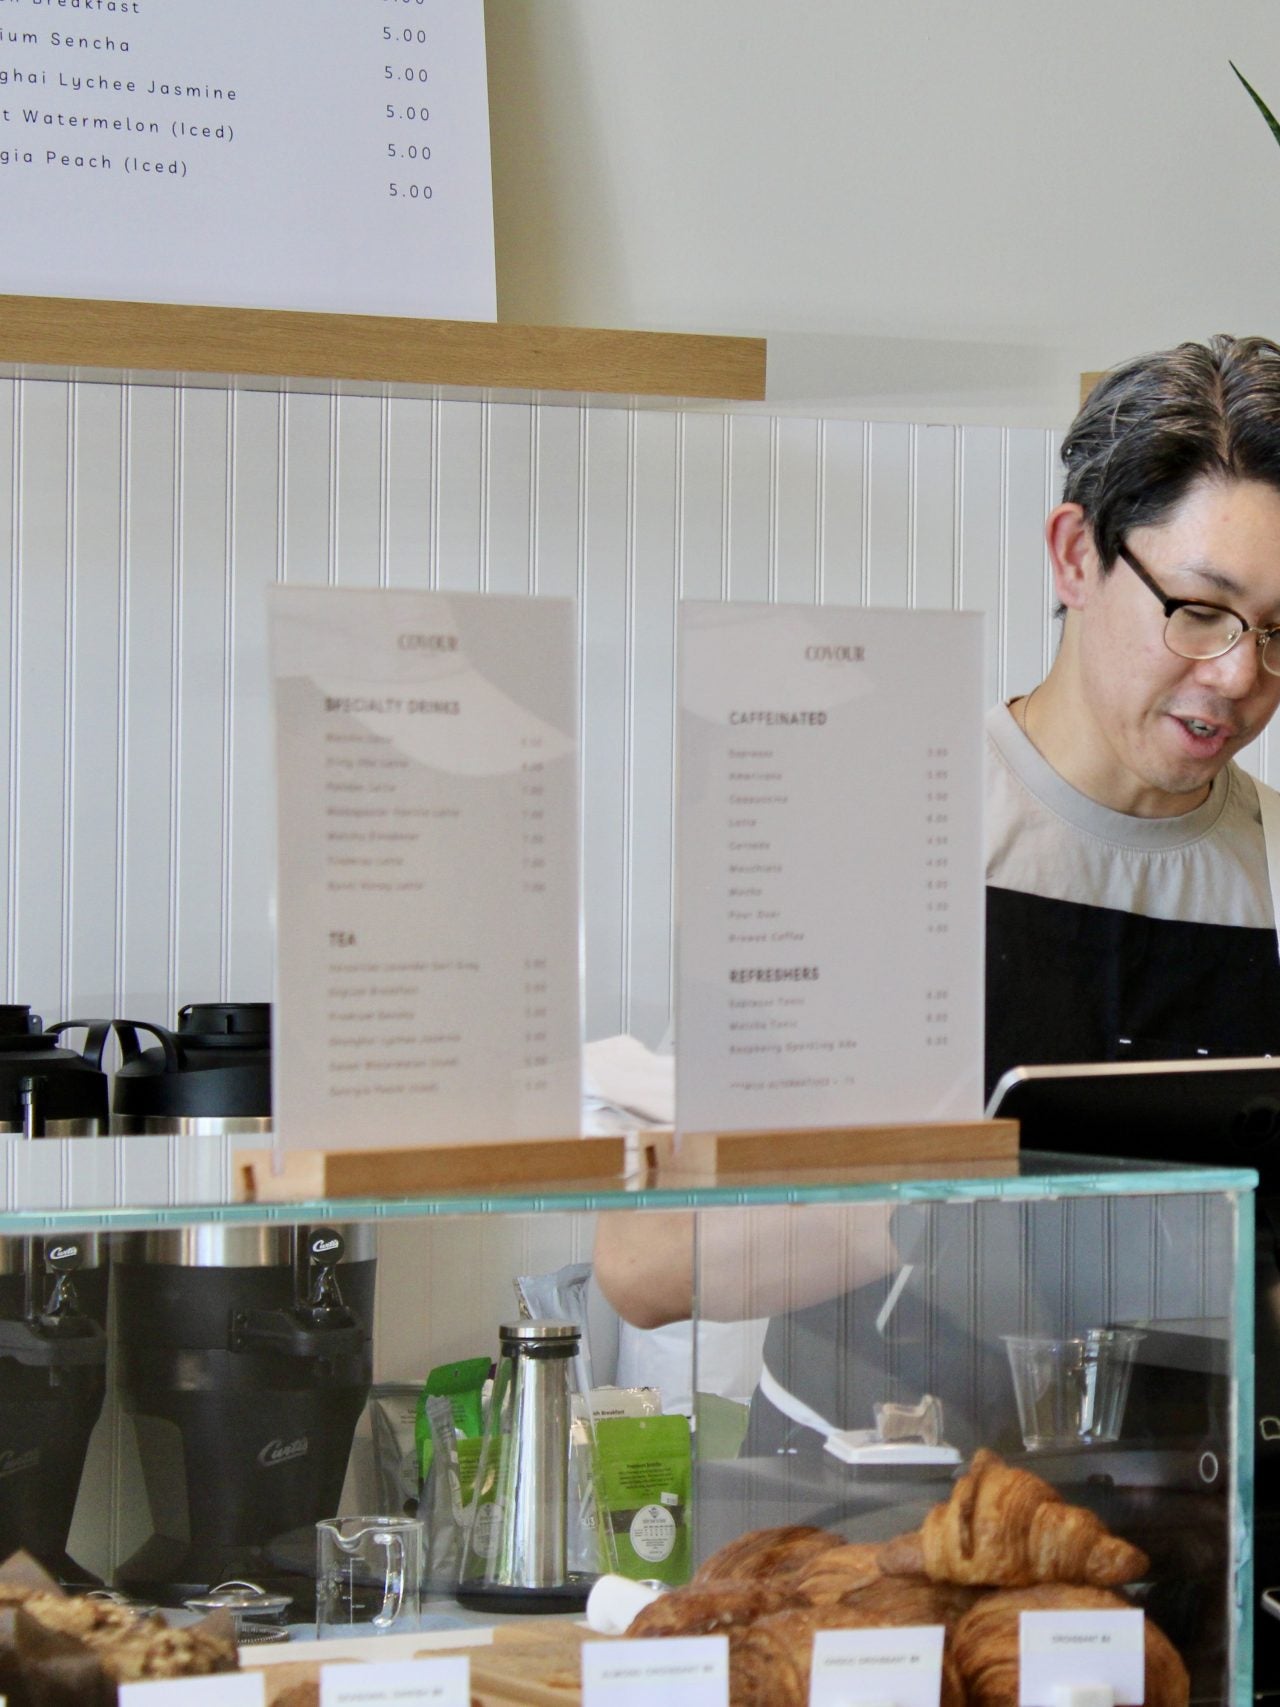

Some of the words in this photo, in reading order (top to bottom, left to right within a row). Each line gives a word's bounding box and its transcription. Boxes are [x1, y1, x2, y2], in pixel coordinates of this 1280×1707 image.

[51, 32, 129, 52] Sencha
[383, 26, 426, 43] 5.00
[384, 65, 428, 83] 5.00
[0, 68, 46, 84] ghai
[59, 72, 136, 91] Lychee
[147, 80, 237, 100] Jasmine
[386, 104, 430, 122] 5.00
[23, 109, 159, 134] Watermelon
[171, 121, 235, 142] (Iced)
[388, 143, 431, 161] 5.00
[0, 149, 33, 164] gia
[46, 151, 111, 169] Peach
[124, 157, 188, 177] (Iced)
[389, 182, 433, 200] 5.00
[729, 710, 828, 726] CAFFEINATED
[729, 966, 820, 983] REFRESHERS
